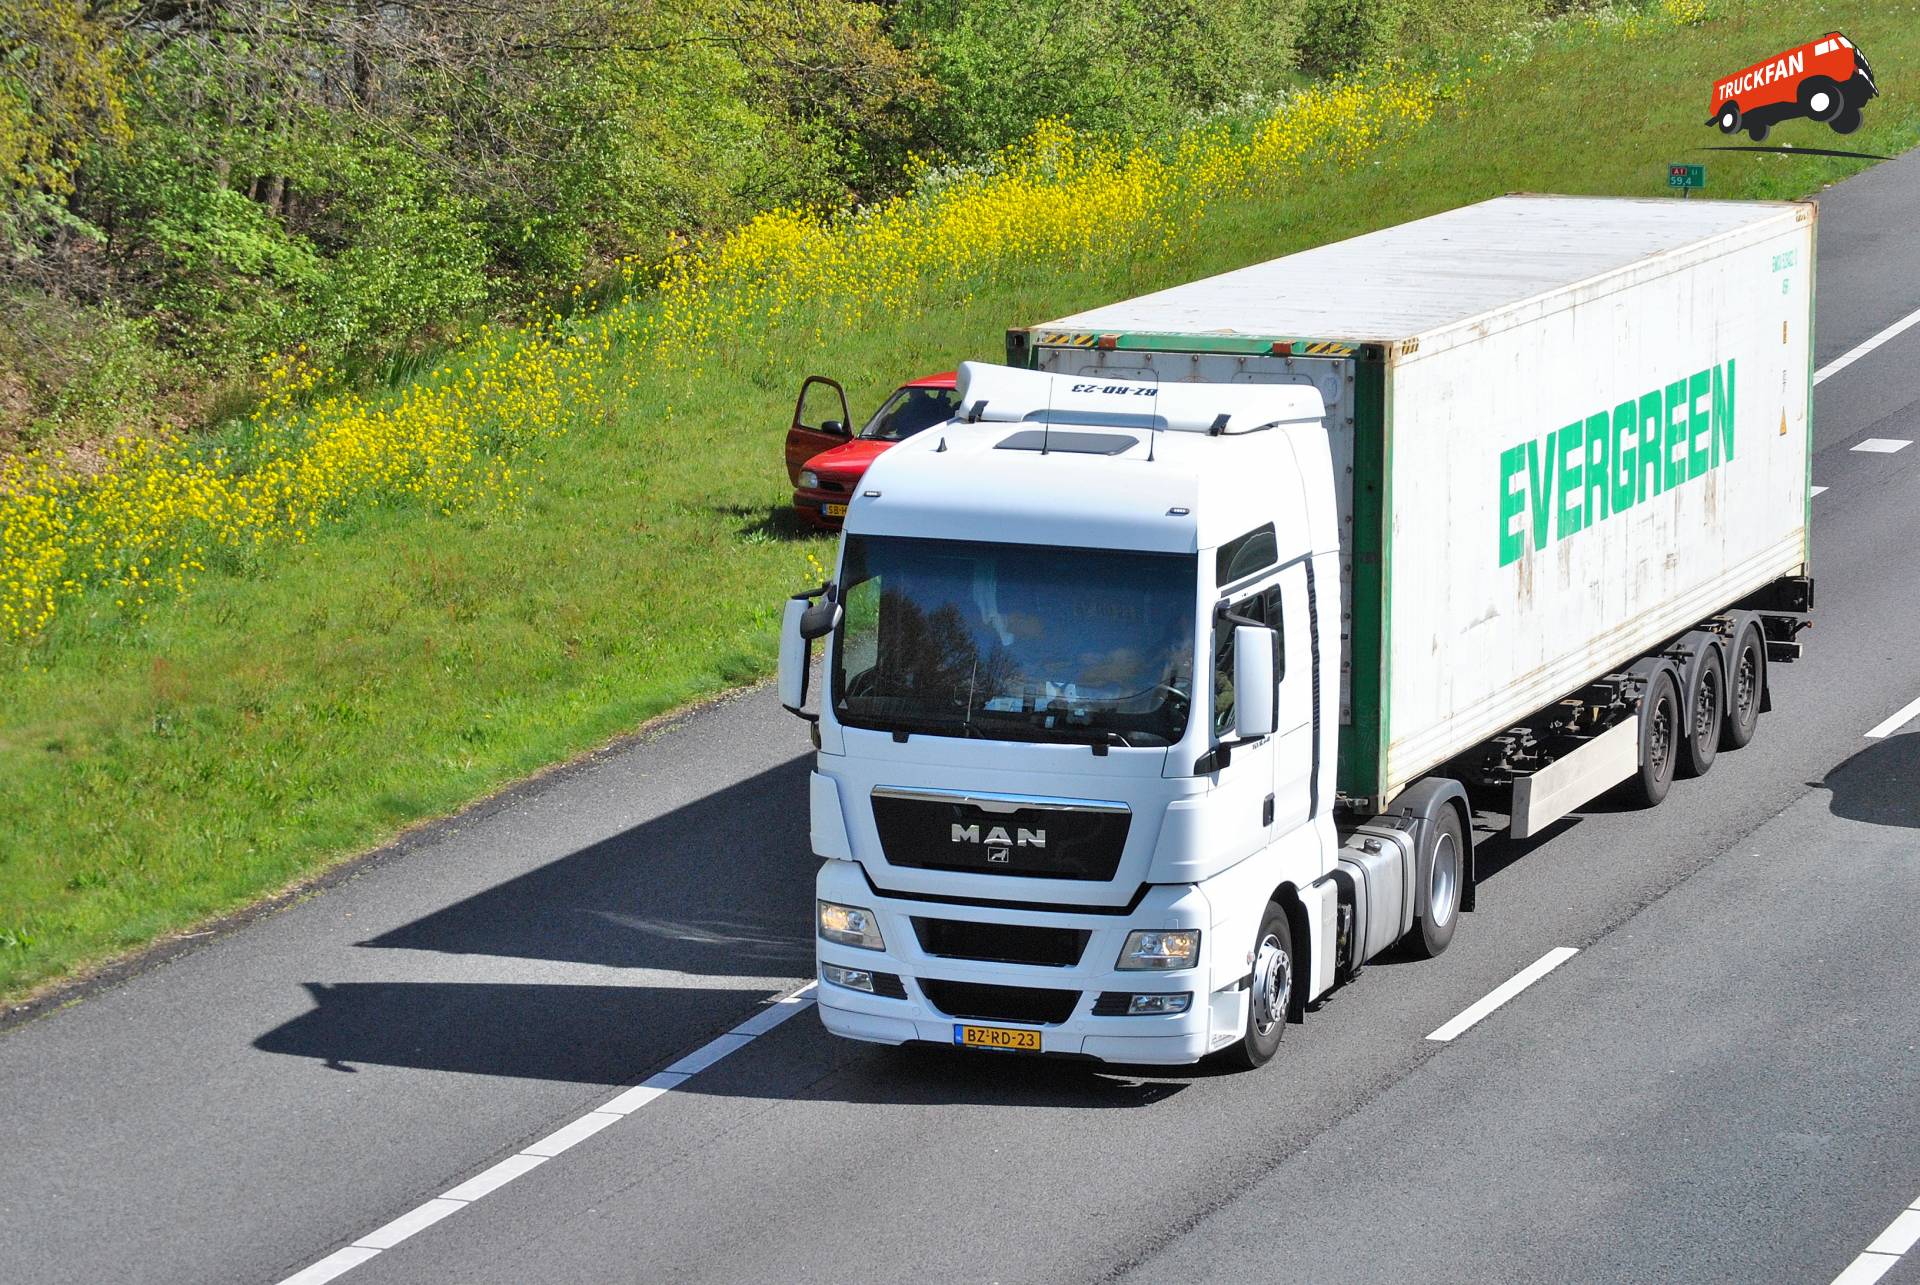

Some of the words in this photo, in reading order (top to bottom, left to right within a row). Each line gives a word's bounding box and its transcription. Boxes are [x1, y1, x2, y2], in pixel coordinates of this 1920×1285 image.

[1674, 167, 1684, 176] A1
[1498, 358, 1736, 568] EVERGREEN
[951, 823, 1046, 848] MAN
[967, 1028, 1035, 1047] BZ-RD-23
